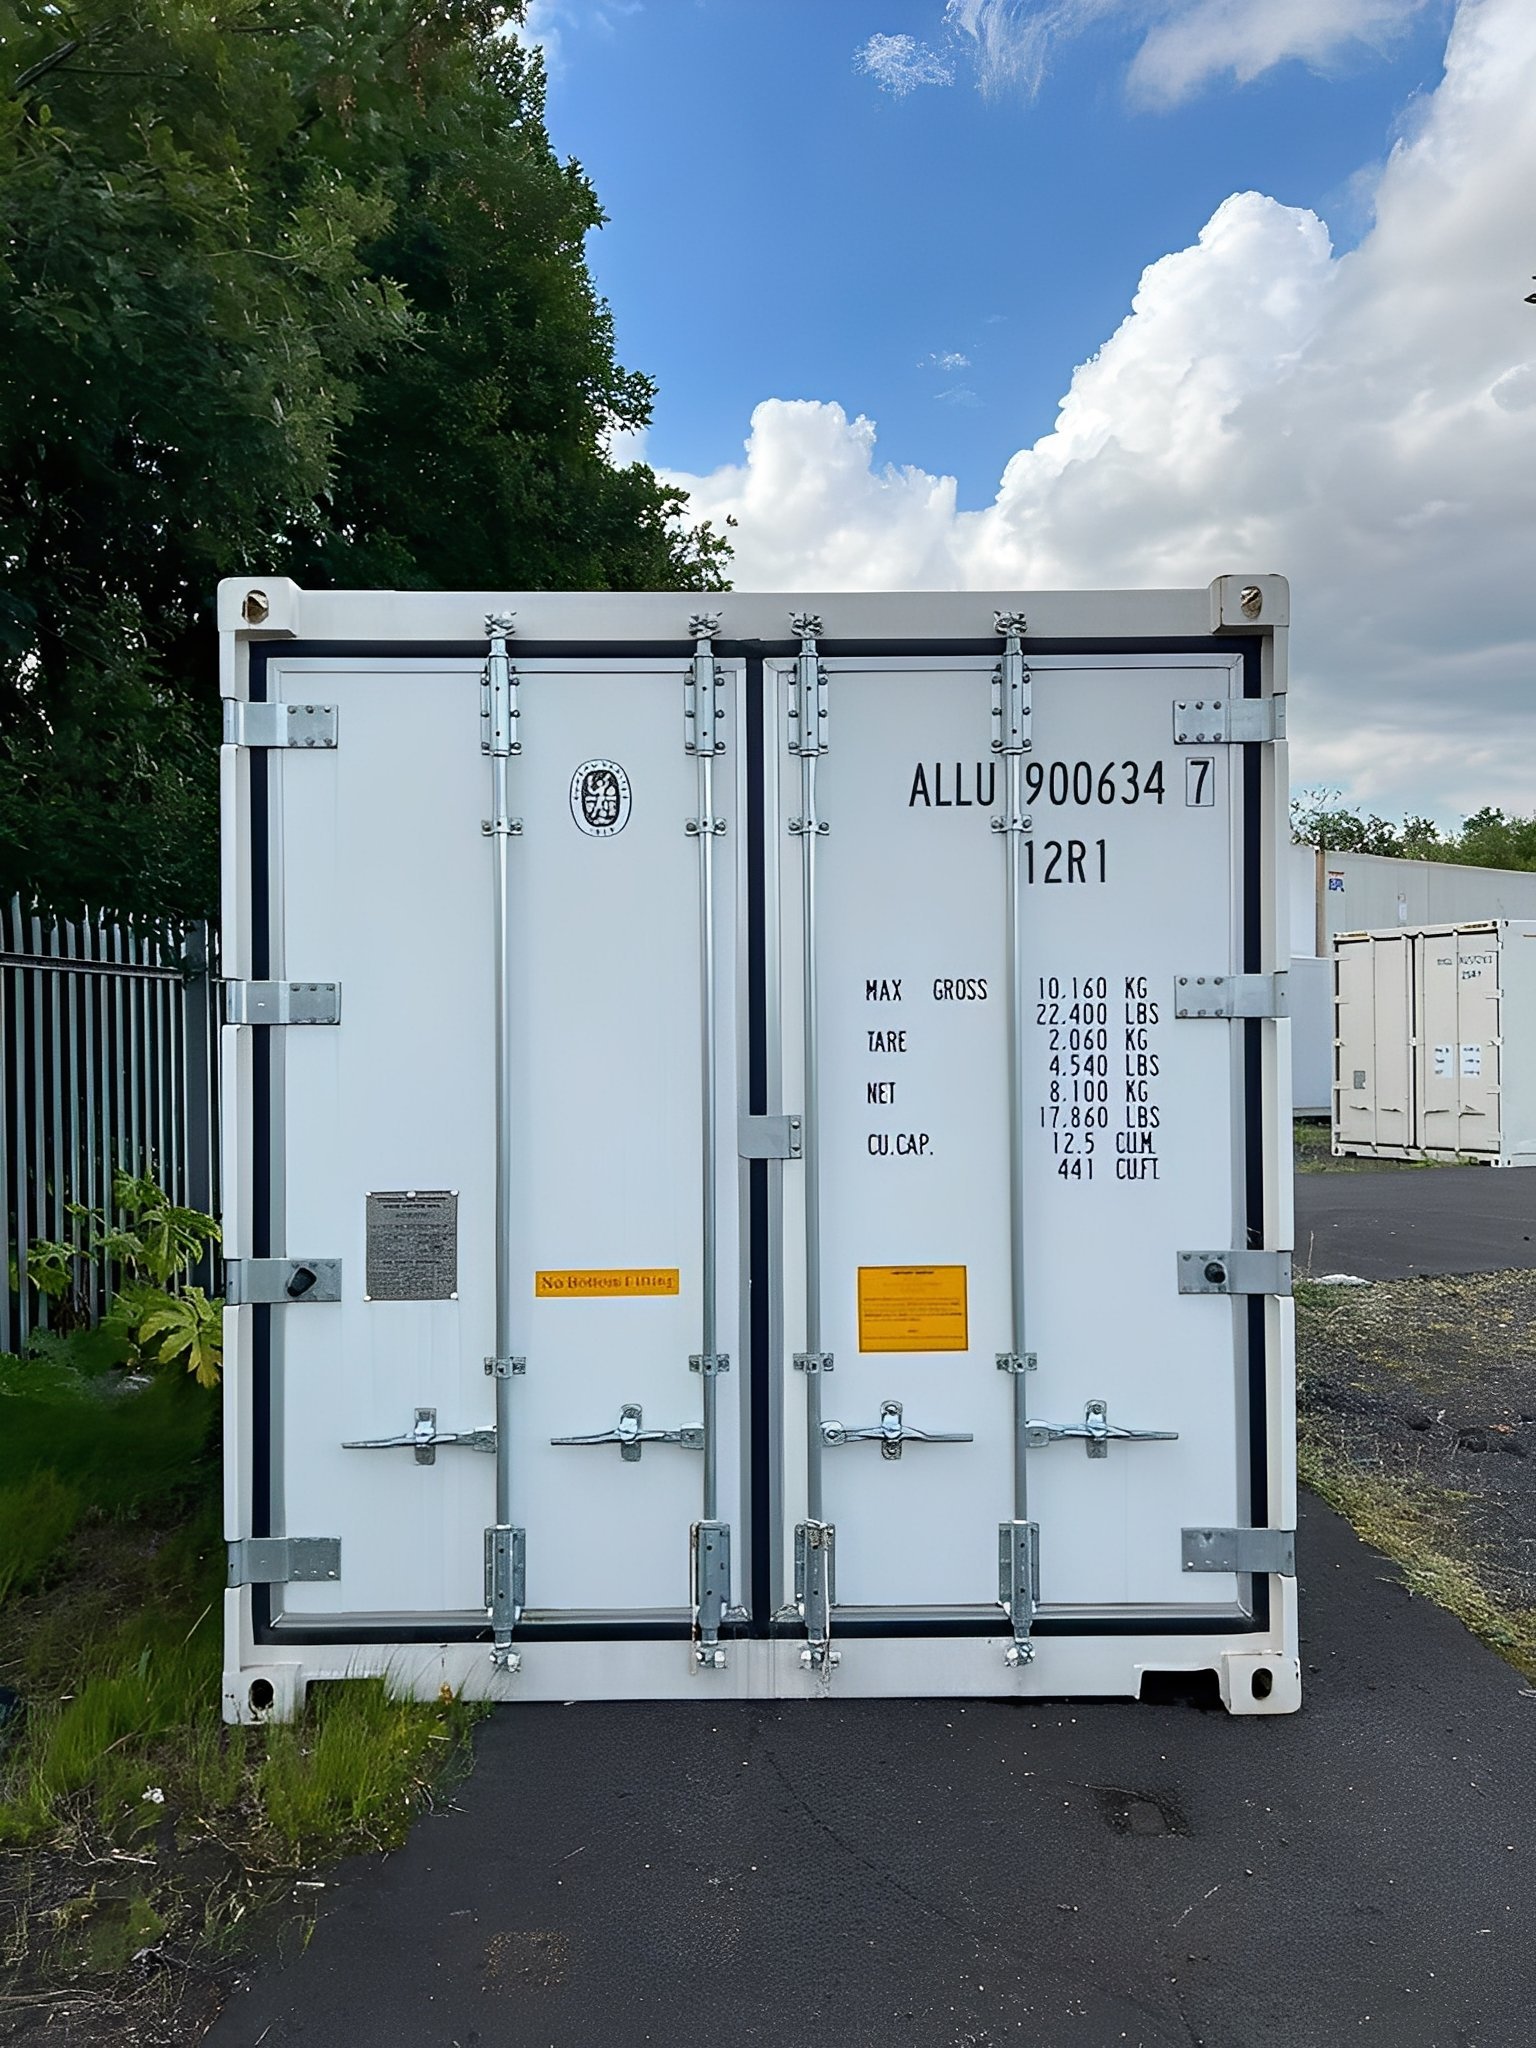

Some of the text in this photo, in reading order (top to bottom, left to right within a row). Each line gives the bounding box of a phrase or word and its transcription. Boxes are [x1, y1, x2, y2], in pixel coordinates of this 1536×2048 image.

[909, 760, 1210, 807] ALLU 900634 7
[1024, 839, 1106, 884] 12R1
[866, 979, 902, 1001] MAX
[932, 978, 988, 1001] GROSS
[1125, 976, 1148, 1000] KG
[1125, 1003, 1159, 1025] LBS
[868, 1030, 907, 1052] TARE
[1125, 1028, 1148, 1051] KG
[1126, 1054, 1159, 1077] LBS
[867, 1082, 896, 1104] NET
[1126, 1080, 1148, 1102] KG
[1126, 1106, 1160, 1128] LBS
[868, 1133, 934, 1155] CU.CAP.
[1054, 1132, 1095, 1154] 12.5
[1058, 1158, 1093, 1180] 441
[541, 1276, 565, 1289] No
